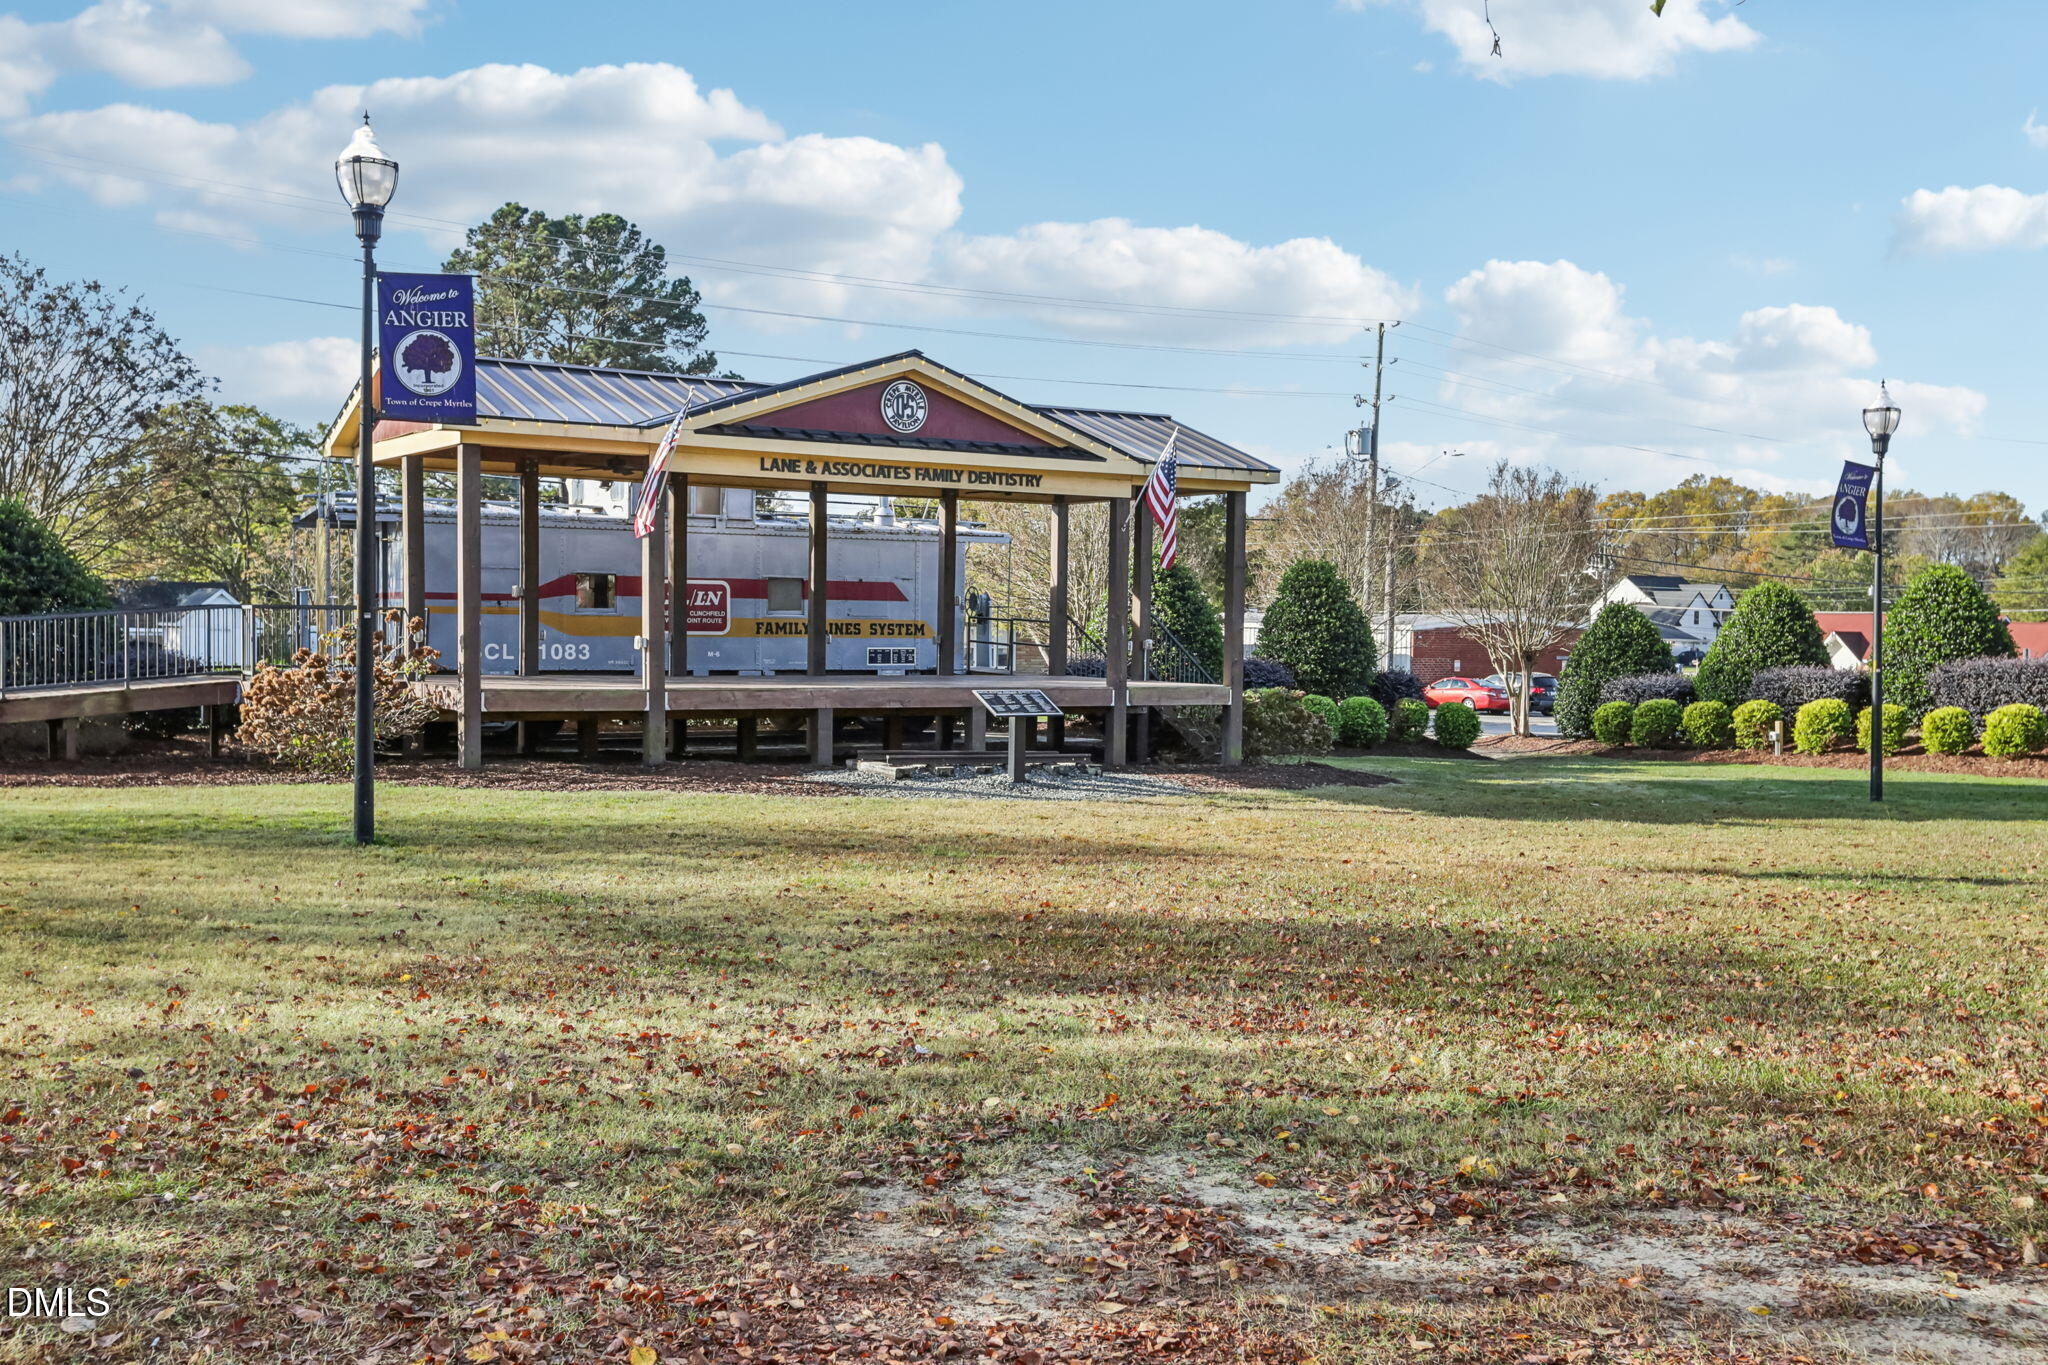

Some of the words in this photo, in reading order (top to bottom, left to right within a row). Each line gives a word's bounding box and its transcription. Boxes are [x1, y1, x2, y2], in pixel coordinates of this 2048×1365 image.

[392, 285, 446, 306] Welcome
[448, 288, 459, 298] to
[384, 309, 469, 328] ANGIER
[385, 397, 407, 405] Town
[409, 398, 417, 406] of
[419, 398, 442, 408] Crepe
[444, 399, 473, 408] Myrtles
[886, 385, 901, 408] CREPE
[889, 414, 921, 429] PAVILION
[760, 457, 801, 473] LANE
[805, 460, 817, 474] &
[821, 461, 911, 480] ASSOCIATES
[915, 467, 963, 483] FAMILY
[968, 470, 1043, 488] DENTISTRY
[1839, 482, 1866, 497] ANGIER
[755, 622, 808, 635] FAMILY
[826, 623, 861, 636] INES
[869, 623, 925, 636] SYSTEM
[480, 643, 515, 660] CL
[538, 643, 590, 660] 1083
